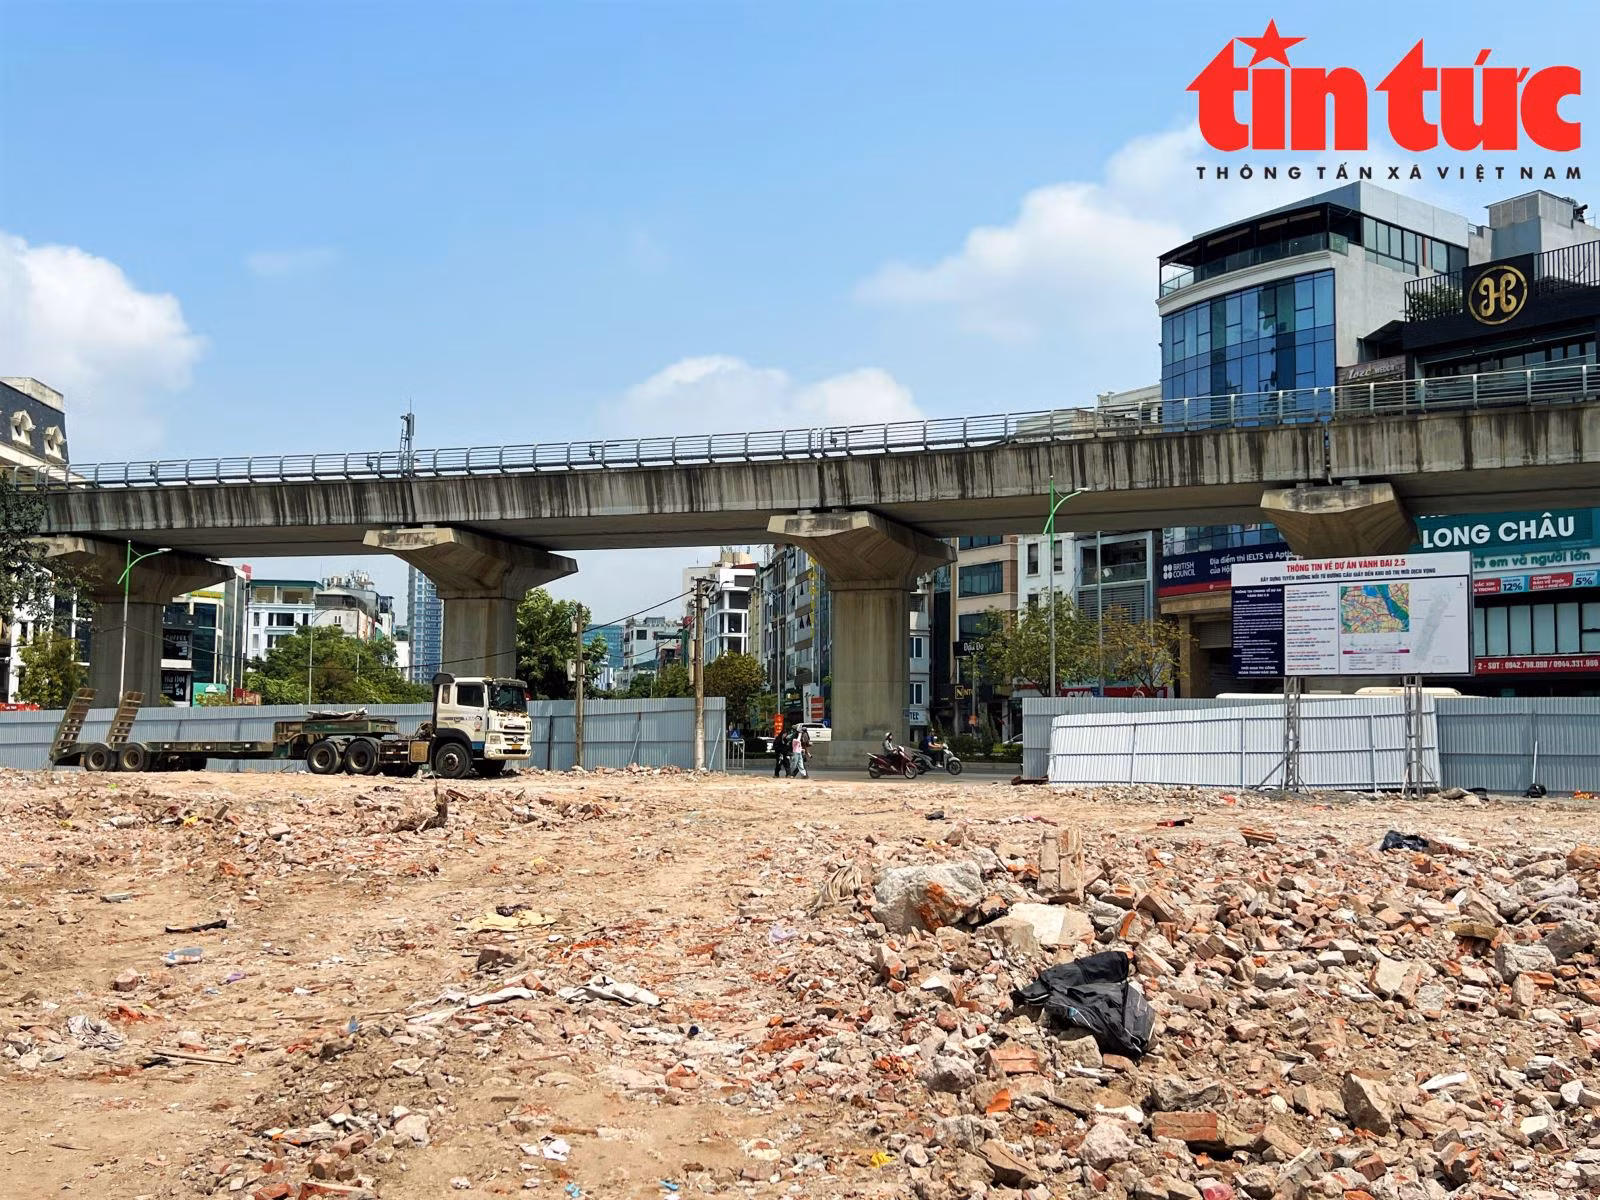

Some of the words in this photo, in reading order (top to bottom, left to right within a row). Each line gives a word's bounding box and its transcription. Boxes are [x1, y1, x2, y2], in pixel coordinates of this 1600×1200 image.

[1422, 524, 1491, 549] LONG
[1498, 512, 1574, 542] CHÂU
[1209, 557, 1220, 568] Địa
[1220, 553, 1236, 564] điểm
[1246, 553, 1263, 561] IELTS
[1489, 559, 1508, 568] em
[1512, 554, 1527, 566] và
[1531, 551, 1566, 566] người
[1570, 549, 1591, 561] lớn
[1173, 562, 1195, 571] BRITISH
[1286, 562, 1310, 572] THÔNG
[1311, 563, 1323, 571] TIN
[1324, 560, 1333, 570] VỀ
[1394, 558, 1406, 567] 2.5
[1173, 570, 1196, 579] COUNCIL
[1503, 582, 1522, 592] 12%
[1575, 577, 1592, 586] 5%
